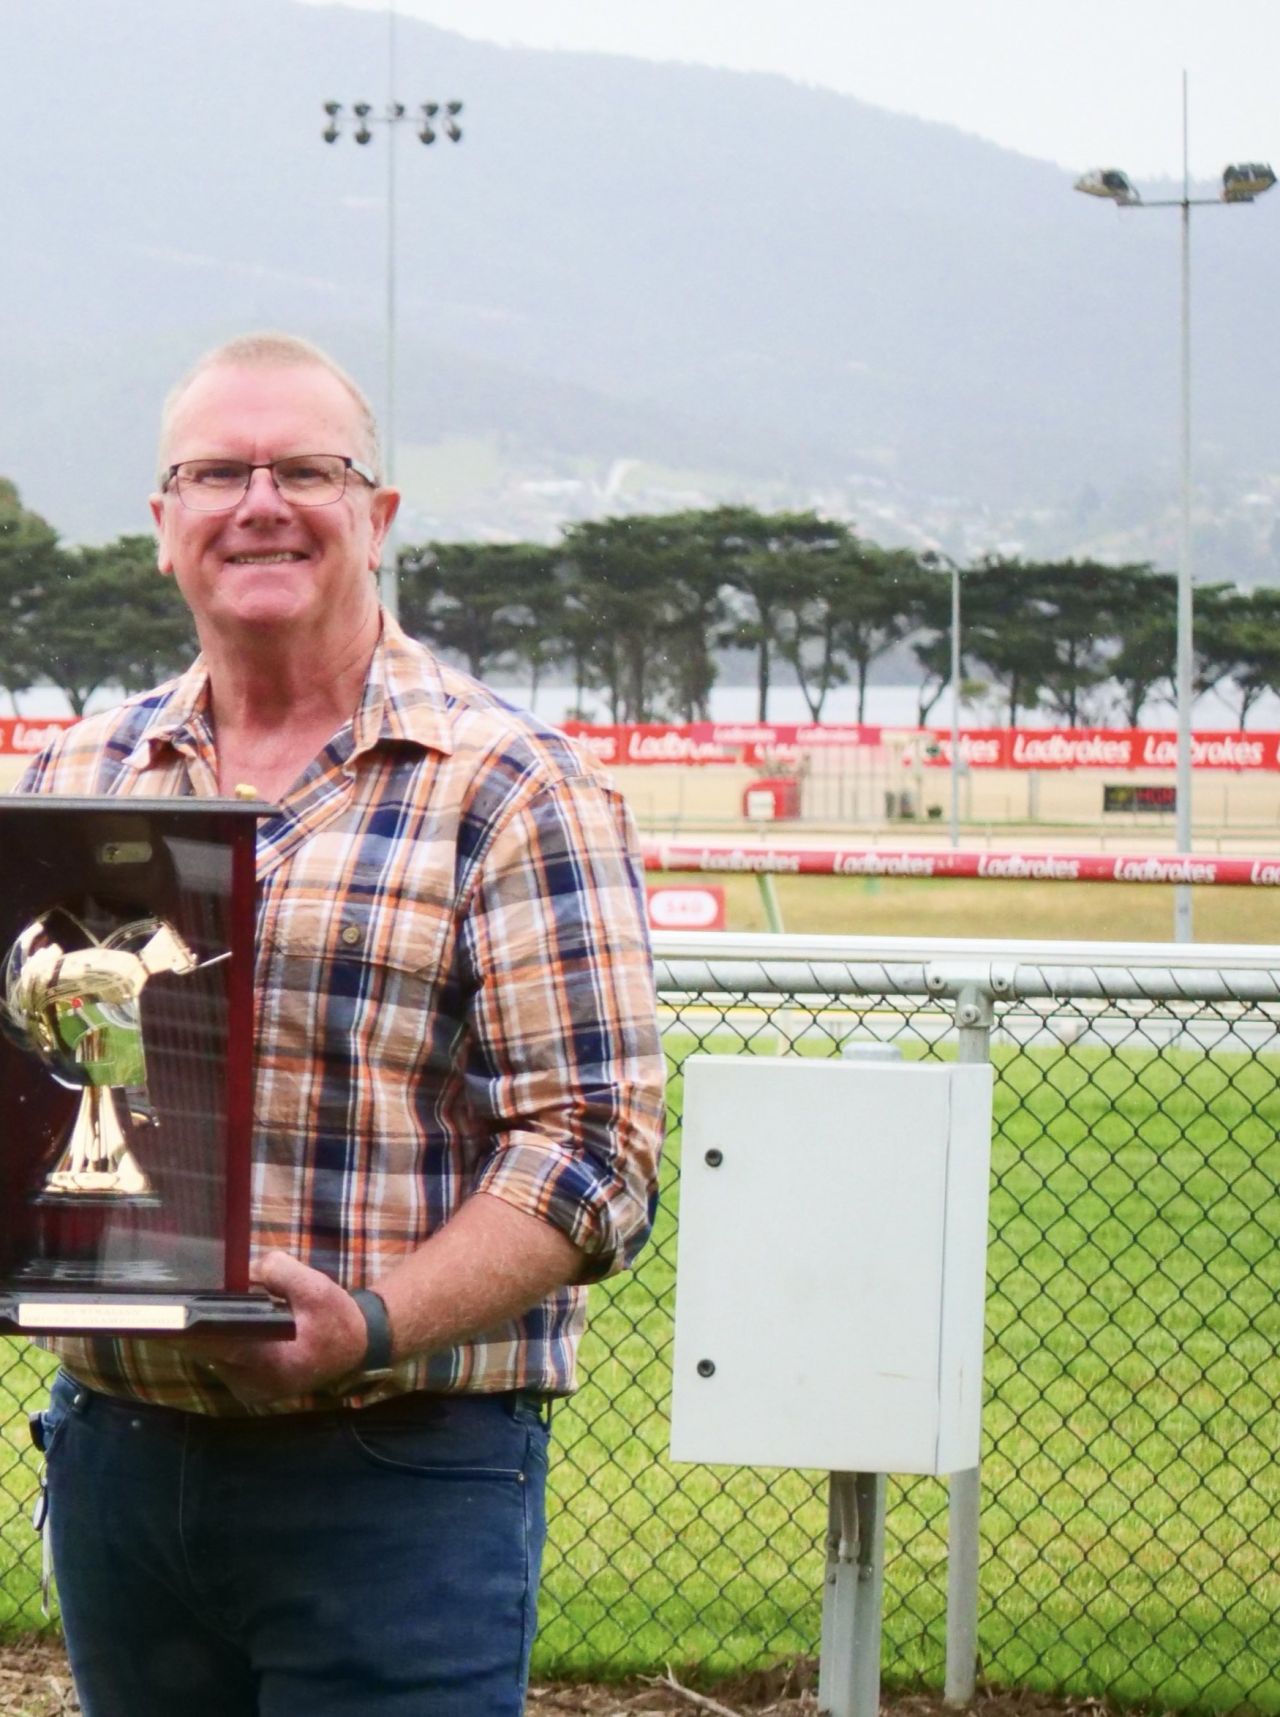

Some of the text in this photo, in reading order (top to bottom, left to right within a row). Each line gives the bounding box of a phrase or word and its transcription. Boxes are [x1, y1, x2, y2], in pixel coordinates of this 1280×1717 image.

[1013, 733, 1132, 764] Ladbrokes
[1143, 735, 1264, 766] Larokes
[977, 854, 1080, 880] Ladbrokes
[1113, 857, 1217, 884] Ladbrokes
